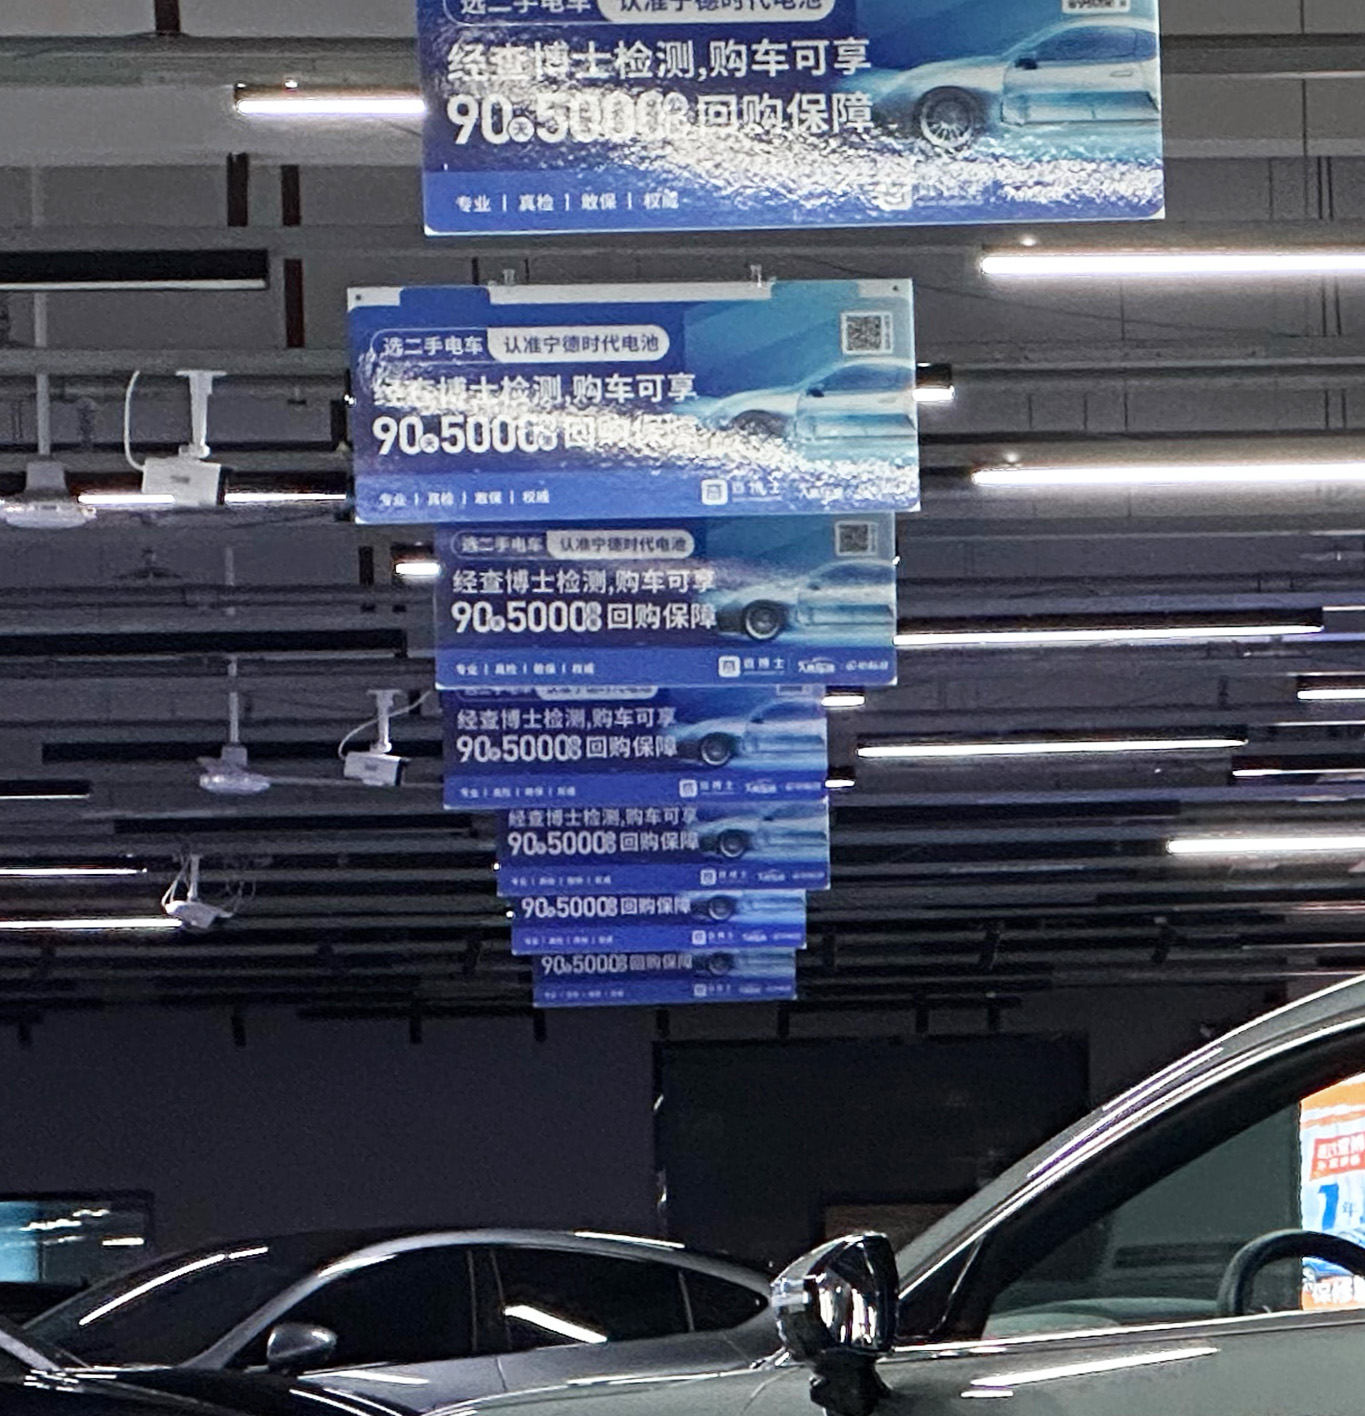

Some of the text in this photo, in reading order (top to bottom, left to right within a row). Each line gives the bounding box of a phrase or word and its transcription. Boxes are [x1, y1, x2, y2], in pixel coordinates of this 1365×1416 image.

[383, 333, 659, 358] 选二手电车 认准宁德时代电池
